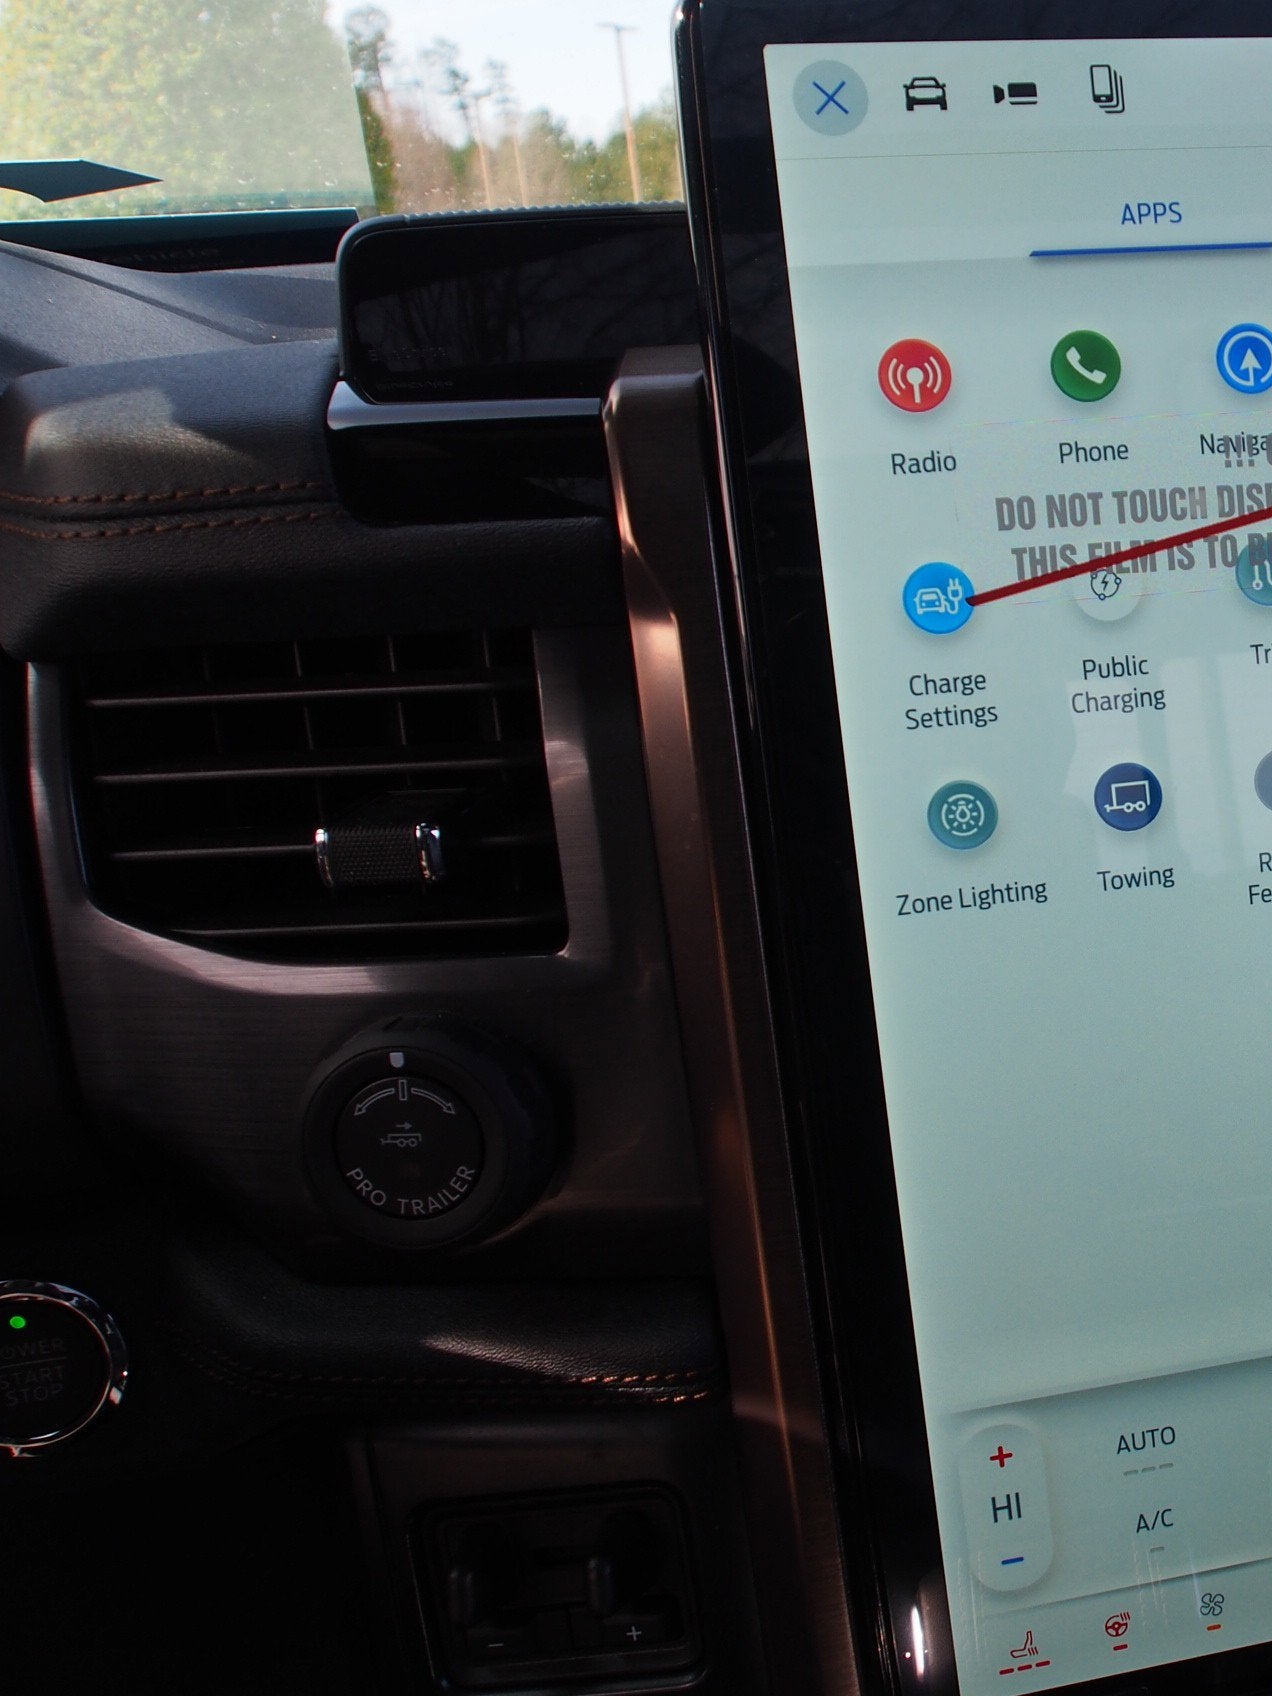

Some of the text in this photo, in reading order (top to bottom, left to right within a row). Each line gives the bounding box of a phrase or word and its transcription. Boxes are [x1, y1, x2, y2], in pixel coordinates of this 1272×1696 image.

[1120, 201, 1183, 226] APPS
[891, 450, 957, 475] Radio
[1058, 440, 1130, 464] Phone
[994, 495, 1037, 533] DO
[1045, 491, 1104, 529] NOT
[1111, 485, 1209, 524] TOUCH
[1010, 543, 1079, 583] THIS
[1164, 540, 1197, 572] IS
[1203, 533, 1240, 570] TO
[1081, 655, 1150, 681] Public
[908, 673, 987, 698] Charge
[1071, 687, 1167, 714] Charging
[905, 704, 999, 731] Settings
[1097, 865, 1175, 893] Towing
[896, 880, 1048, 916] Zone Lighting
[346, 1165, 476, 1215] PRO TRAILER
[0, 1337, 64, 1360] OWER
[6, 1384, 65, 1407] STOP
[1116, 1426, 1176, 1455] AUTO
[991, 1491, 1022, 1523] HI
[1135, 1508, 1175, 1534] A/C
